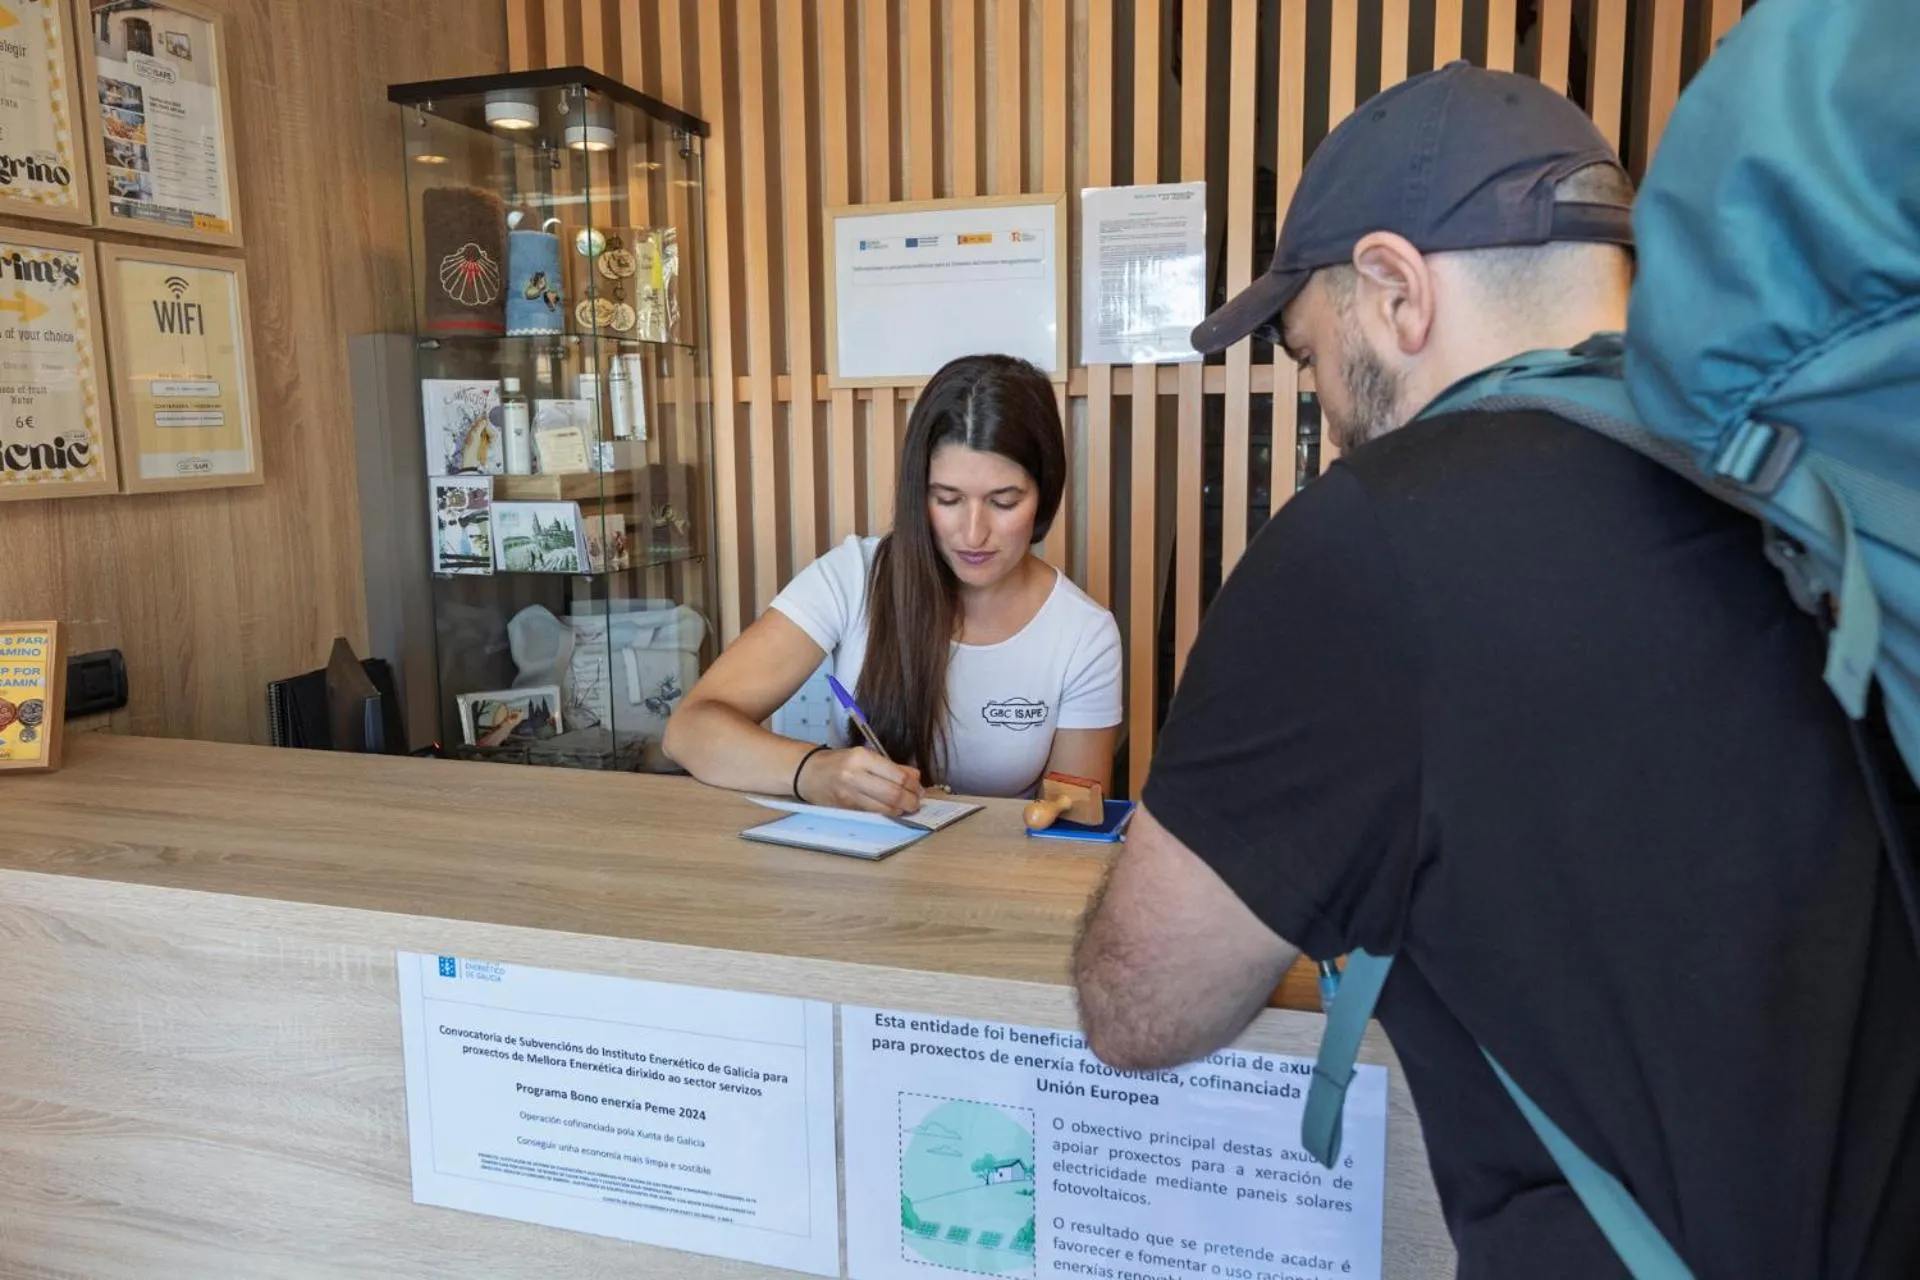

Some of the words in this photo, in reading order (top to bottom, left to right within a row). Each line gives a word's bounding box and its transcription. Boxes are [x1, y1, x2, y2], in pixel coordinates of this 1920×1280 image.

[19, 330, 41, 343] your
[44, 329, 74, 343] choice
[153, 299, 204, 336] WIFI
[16, 416, 34, 429] 6€
[14, 667, 40, 675] FOR
[439, 1024, 502, 1043] Convocatoria
[505, 1035, 517, 1046] de
[519, 1037, 583, 1054] Subvencións
[586, 1045, 600, 1056] do
[602, 1048, 647, 1063] Instituto
[649, 1054, 705, 1071] Enerxético
[707, 1062, 721, 1074] de
[724, 1065, 760, 1080] Galicia
[763, 1073, 788, 1084] para
[875, 1013, 906, 1029] Esta
[910, 1018, 979, 1037] entidade
[984, 1025, 1004, 1041] foi
[1252, 1055, 1274, 1073] de
[1279, 1062, 1314, 1076] axu
[462, 1045, 510, 1060] proxectos
[512, 1050, 524, 1062] de
[527, 1053, 567, 1067] Mellora
[570, 1059, 623, 1075] Enerxética
[626, 1067, 665, 1081] dirixido
[668, 1074, 681, 1084] ao
[684, 1076, 716, 1090] sector
[719, 1083, 763, 1096] servizos
[872, 1037, 905, 1053] para
[910, 1041, 985, 1061] proxectos
[990, 1048, 1009, 1064] de
[1189, 1074, 1301, 1099] cofinanciada
[516, 1082, 567, 1099] Programa
[570, 1090, 599, 1104] Bono
[644, 1101, 676, 1116] Peme
[679, 1107, 707, 1121] 2024
[1036, 1078, 1085, 1097] Unión
[1091, 1084, 1159, 1106] Europea
[516, 1135, 556, 1150] Conseguir
[519, 1110, 562, 1125] Operación
[563, 1118, 615, 1134] cofinanciada
[617, 1126, 635, 1138] pola
[637, 1129, 662, 1141] Xunta
[664, 1133, 675, 1143] de
[676, 1136, 706, 1148] Galicia
[1052, 1117, 1065, 1131] O
[1071, 1120, 1142, 1141] obxectivo
[1150, 1131, 1216, 1151] principal
[1223, 1139, 1273, 1158] destas
[1343, 1155, 1354, 1169] é
[1052, 1139, 1099, 1156] apoiar
[1109, 1147, 1181, 1167] proxectos
[1191, 1159, 1225, 1174] para
[1235, 1165, 1245, 1177] a
[1255, 1167, 1322, 1187] xeración
[1332, 1176, 1353, 1191] de
[1052, 1159, 1147, 1184] electricidade
[1156, 1174, 1228, 1195] mediante
[1236, 1186, 1288, 1204] paneis
[1296, 1193, 1353, 1212] solares
[1052, 1179, 1152, 1206] fotovoltaicos.
[1052, 1216, 1065, 1230] O
[1071, 1220, 1140, 1242] resultado
[1146, 1232, 1174, 1247] que
[1181, 1238, 1197, 1251] se
[1203, 1241, 1275, 1263] pretende
[1281, 1252, 1334, 1271] acadar
[1341, 1259, 1352, 1274] é
[1052, 1236, 1121, 1259] favorecer
[1125, 1249, 1134, 1261] e
[1138, 1249, 1207, 1273] fomentar
[1211, 1263, 1221, 1275] o
[1226, 1265, 1253, 1280] uso
[1053, 1258, 1114, 1279] enerxías
